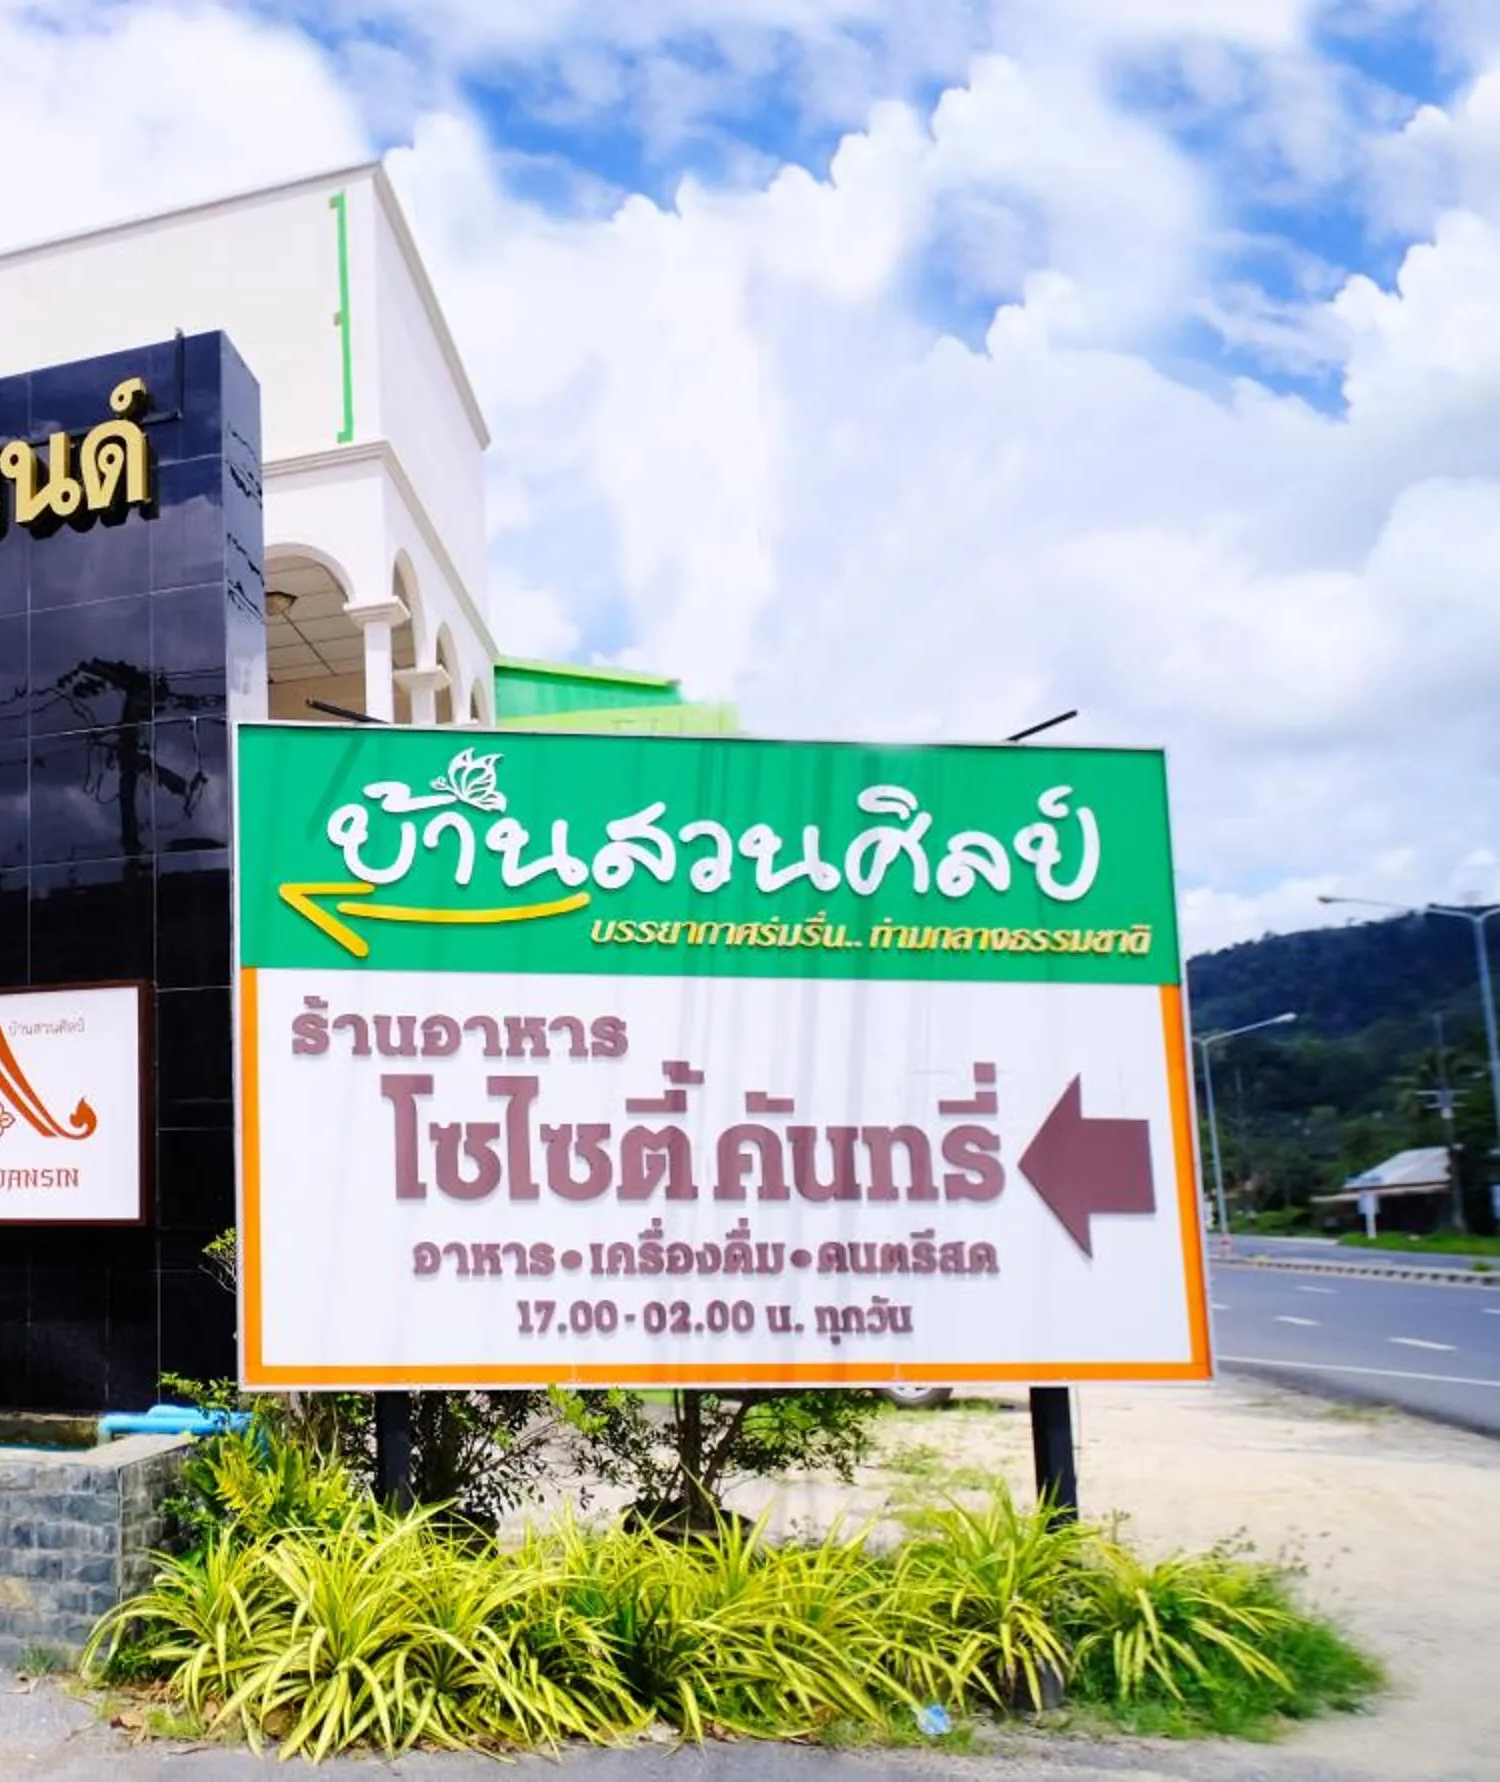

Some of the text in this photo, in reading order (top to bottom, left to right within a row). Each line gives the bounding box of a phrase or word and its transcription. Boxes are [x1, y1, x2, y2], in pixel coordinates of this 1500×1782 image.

[327, 778, 1100, 901] บ้านสวนศิลป์
[291, 995, 629, 1058] ร้านอาหาร
[766, 1305, 805, 1334] น.
[814, 1296, 913, 1345] ทุกวัน
